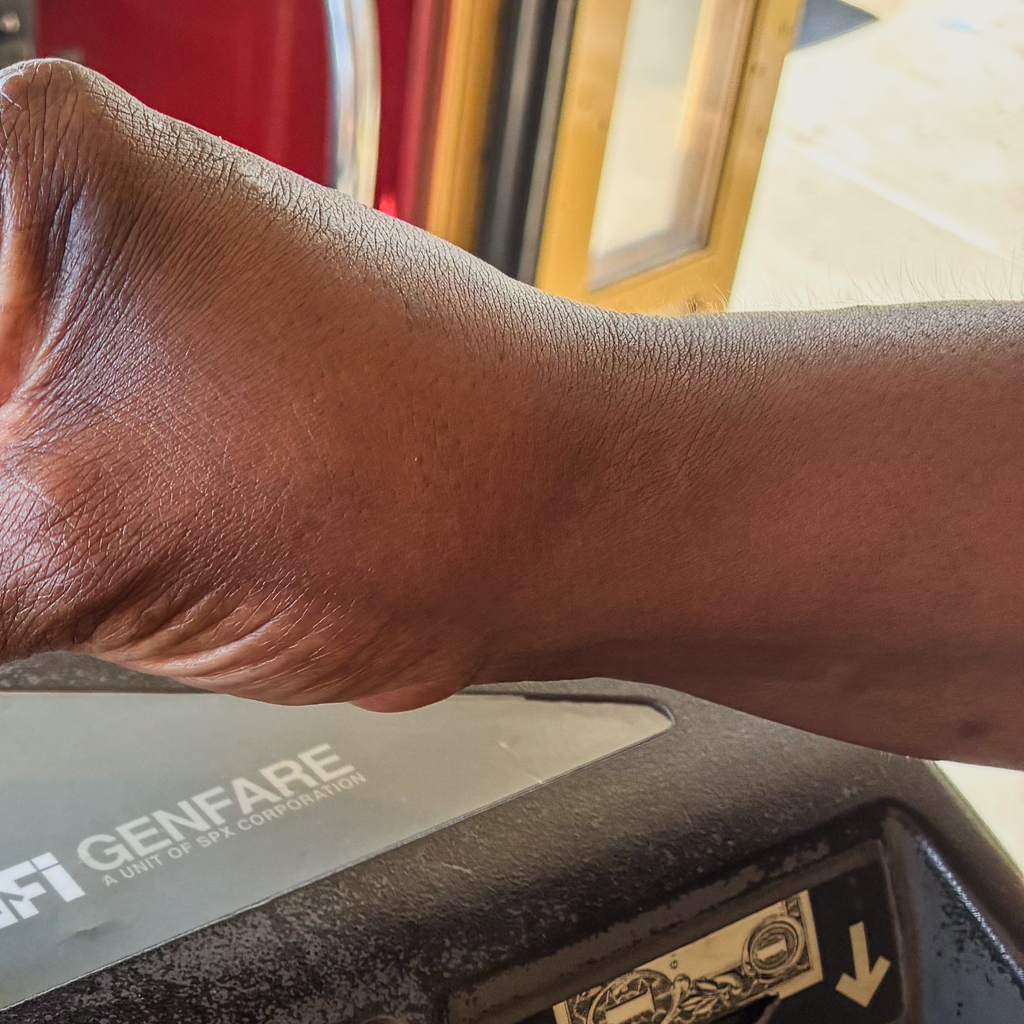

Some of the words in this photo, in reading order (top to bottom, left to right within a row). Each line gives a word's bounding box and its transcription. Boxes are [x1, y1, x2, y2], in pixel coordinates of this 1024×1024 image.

[77, 743, 355, 871] GENFARE
[101, 874, 118, 887] A
[120, 854, 163, 879] UNIT
[168, 841, 193, 859] OF
[196, 827, 236, 849] SPX
[237, 772, 366, 831] CORPORATION
